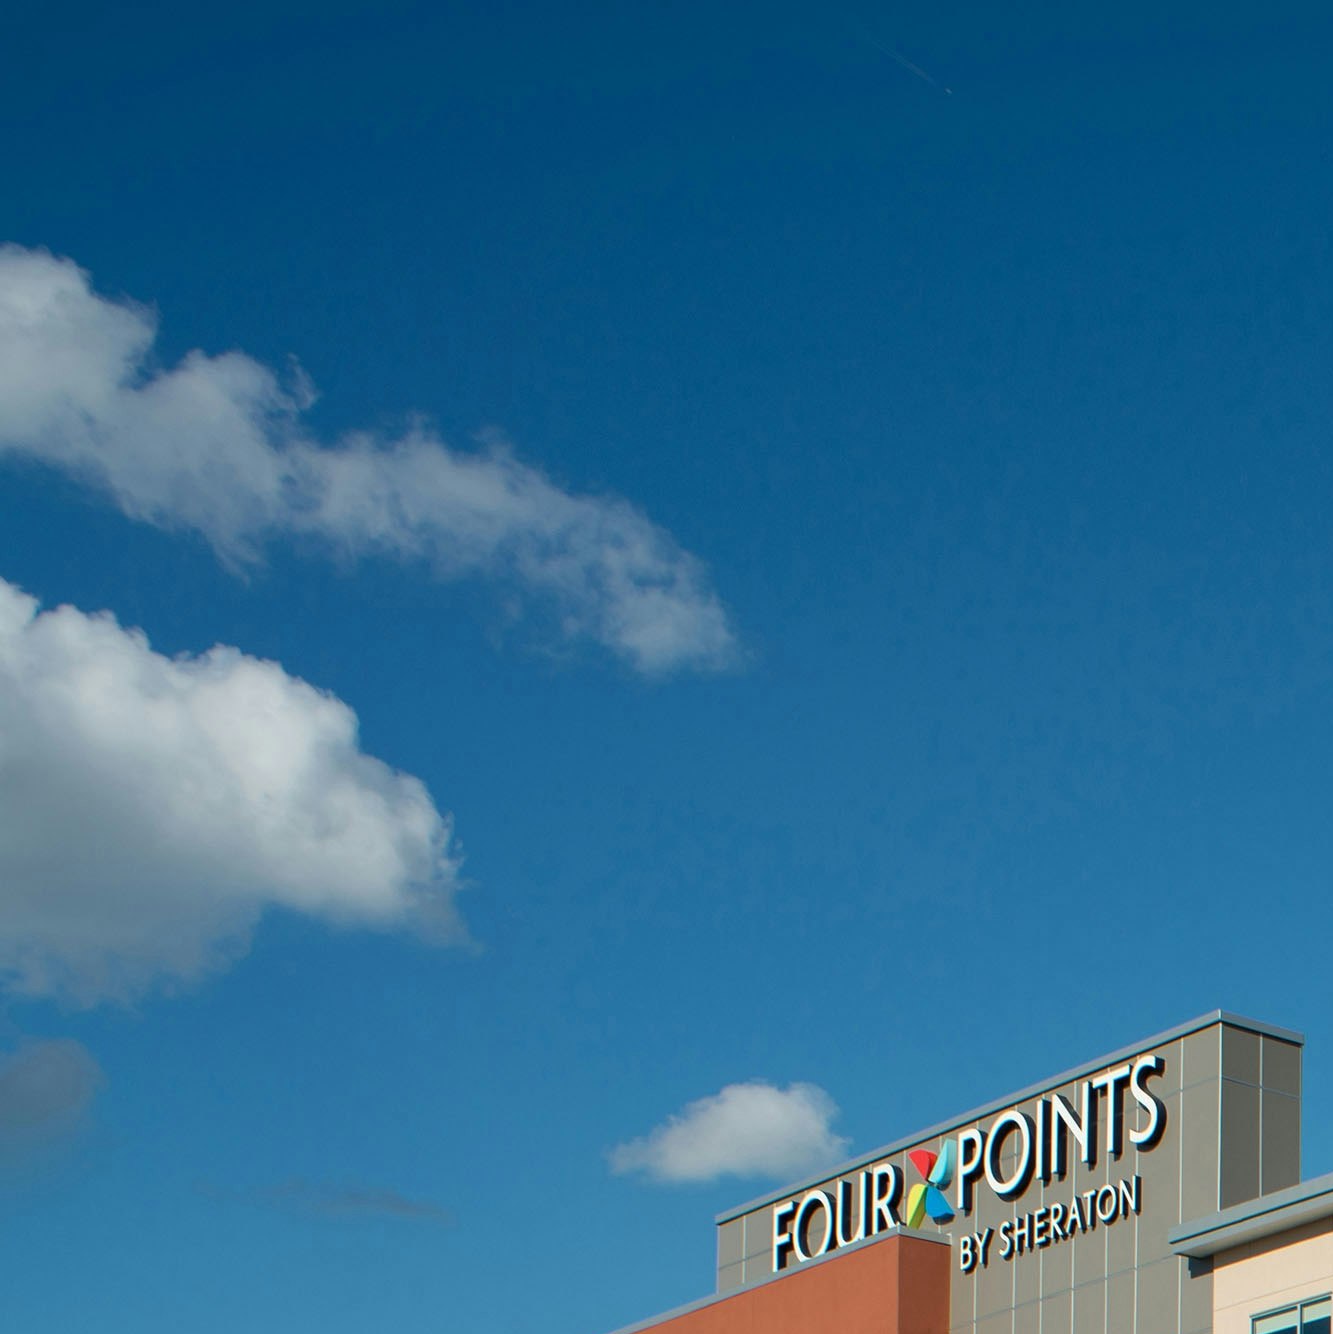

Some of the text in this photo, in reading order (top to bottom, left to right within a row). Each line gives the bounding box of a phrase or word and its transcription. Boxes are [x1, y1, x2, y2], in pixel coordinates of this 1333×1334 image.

[772, 1055, 1167, 1273] FOUR POINTS
[960, 1175, 1143, 1272] BY SHERATON
